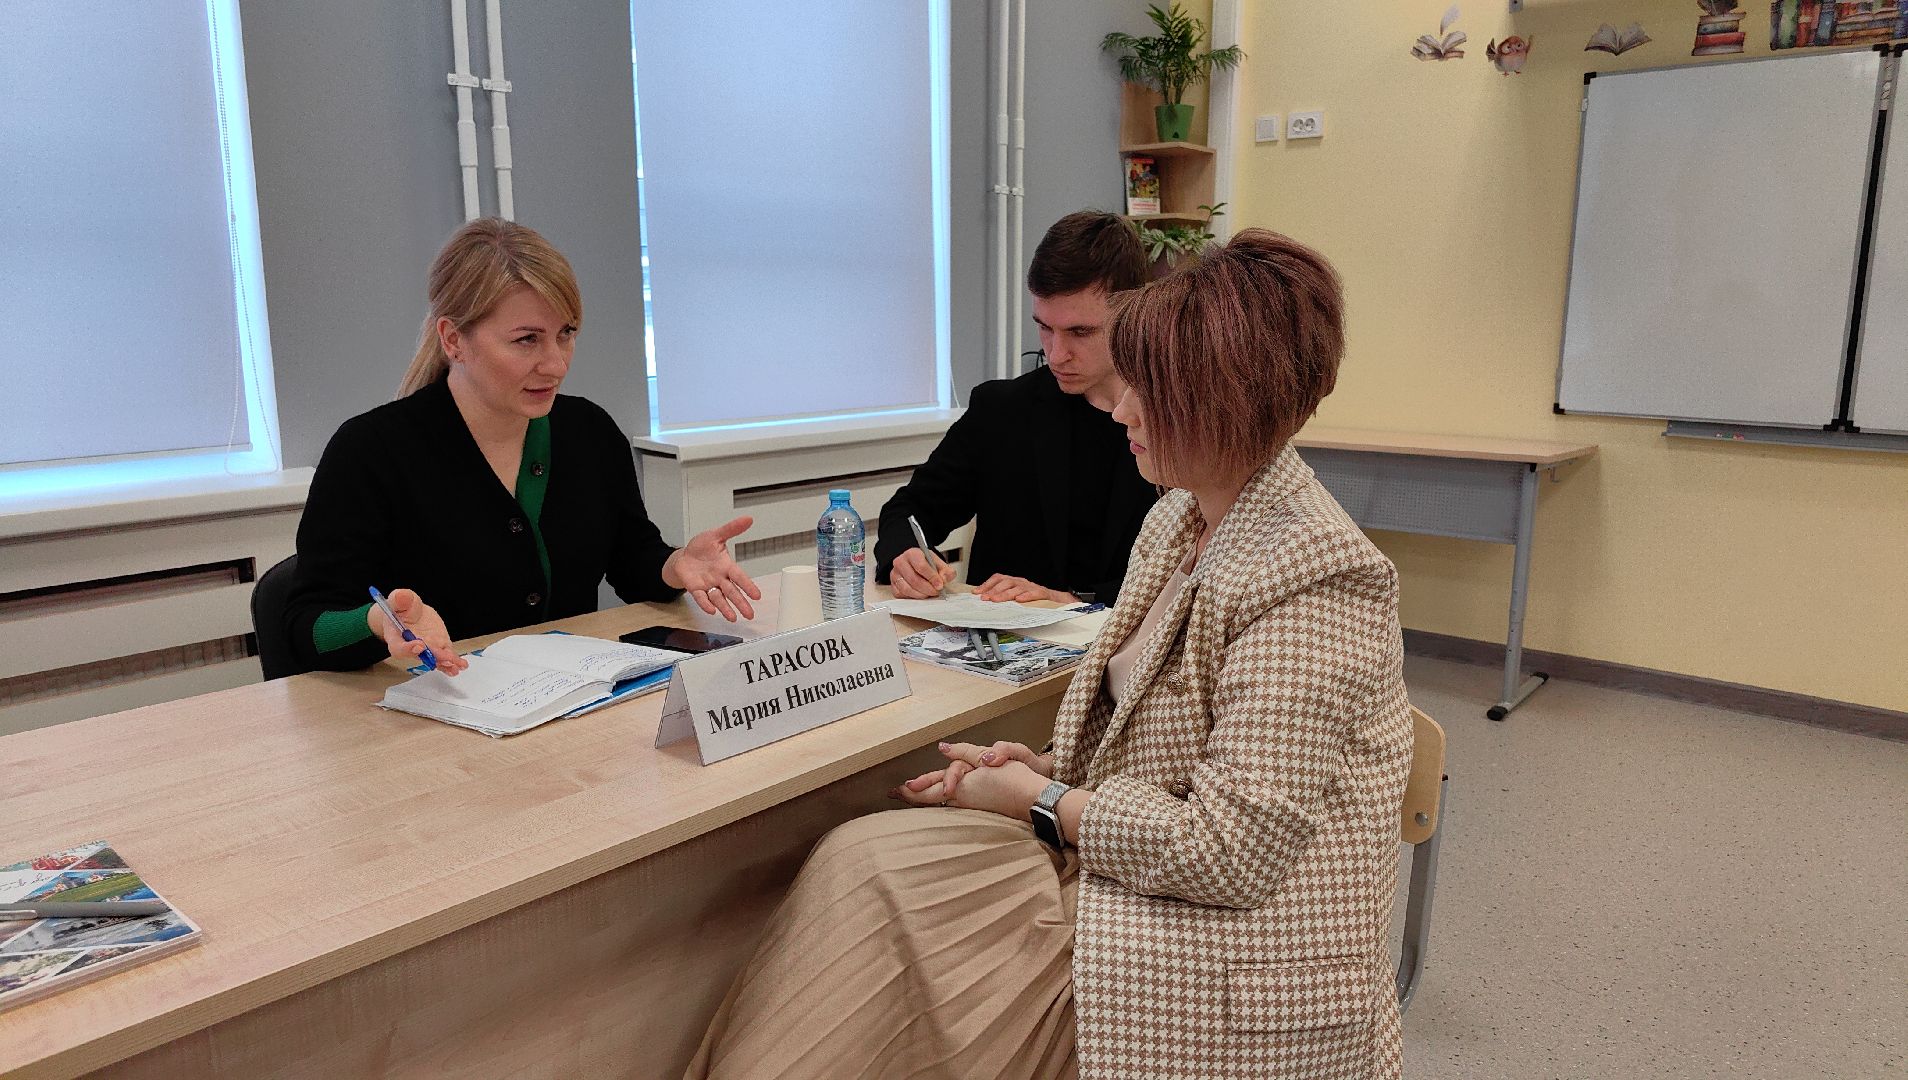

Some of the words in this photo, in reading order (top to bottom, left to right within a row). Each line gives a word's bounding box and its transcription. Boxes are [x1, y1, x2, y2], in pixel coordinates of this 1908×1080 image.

[740, 635, 854, 684] ТАРАСОВА
[707, 697, 782, 734] Мария
[784, 663, 894, 710] Николаевна
